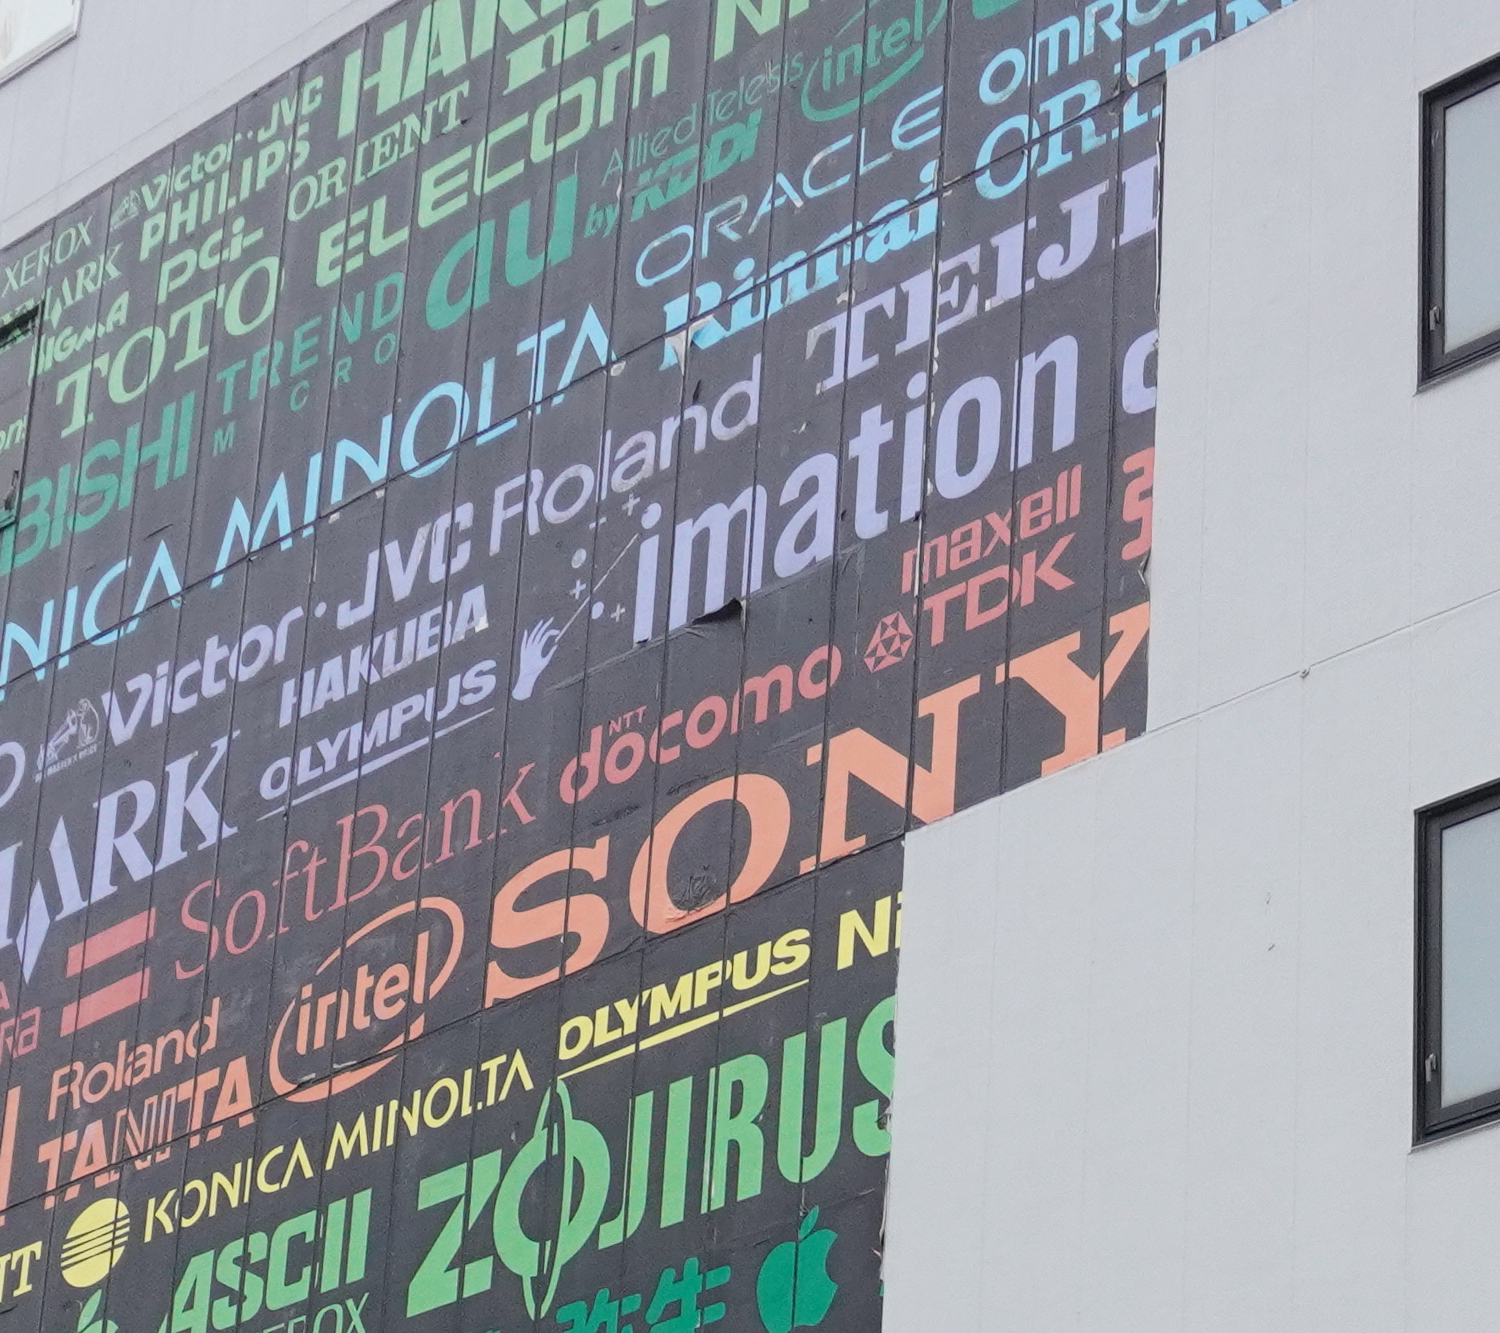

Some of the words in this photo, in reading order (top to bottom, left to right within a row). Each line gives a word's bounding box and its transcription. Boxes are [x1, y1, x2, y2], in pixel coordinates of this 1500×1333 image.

[139, 122, 309, 261] PHILIPS
[287, 84, 472, 222] ORIENT
[316, 33, 670, 287] ELECOM
[601, 104, 697, 185] Allied
[630, 109, 763, 222] KDDI
[636, 86, 944, 288] ORACLE
[2, 216, 95, 297] XEROX
[425, 175, 576, 331] au
[659, 159, 944, 372] Rinnai
[56, 256, 278, 437] TOTO
[217, 272, 406, 412] TREND
[211, 305, 616, 588] MINOLTA
[490, 353, 763, 557] Roland
[634, 334, 1080, 644] imation
[901, 465, 1082, 594] maxell
[922, 532, 1075, 647] TDK
[258, 659, 498, 801] OLYMPUS
[277, 584, 490, 729] HAKUBA
[559, 643, 843, 806] docomo
[607, 707, 647, 738] NTT
[174, 753, 537, 983] SoftBank
[484, 601, 1149, 1010] SONY
[37, 1056, 257, 1210] TANITA
[47, 997, 222, 1120] Roland
[142, 1137, 313, 1243] KONICA
[326, 1049, 535, 1172] MINOLTA
[559, 928, 812, 1063] OLYMPUS
